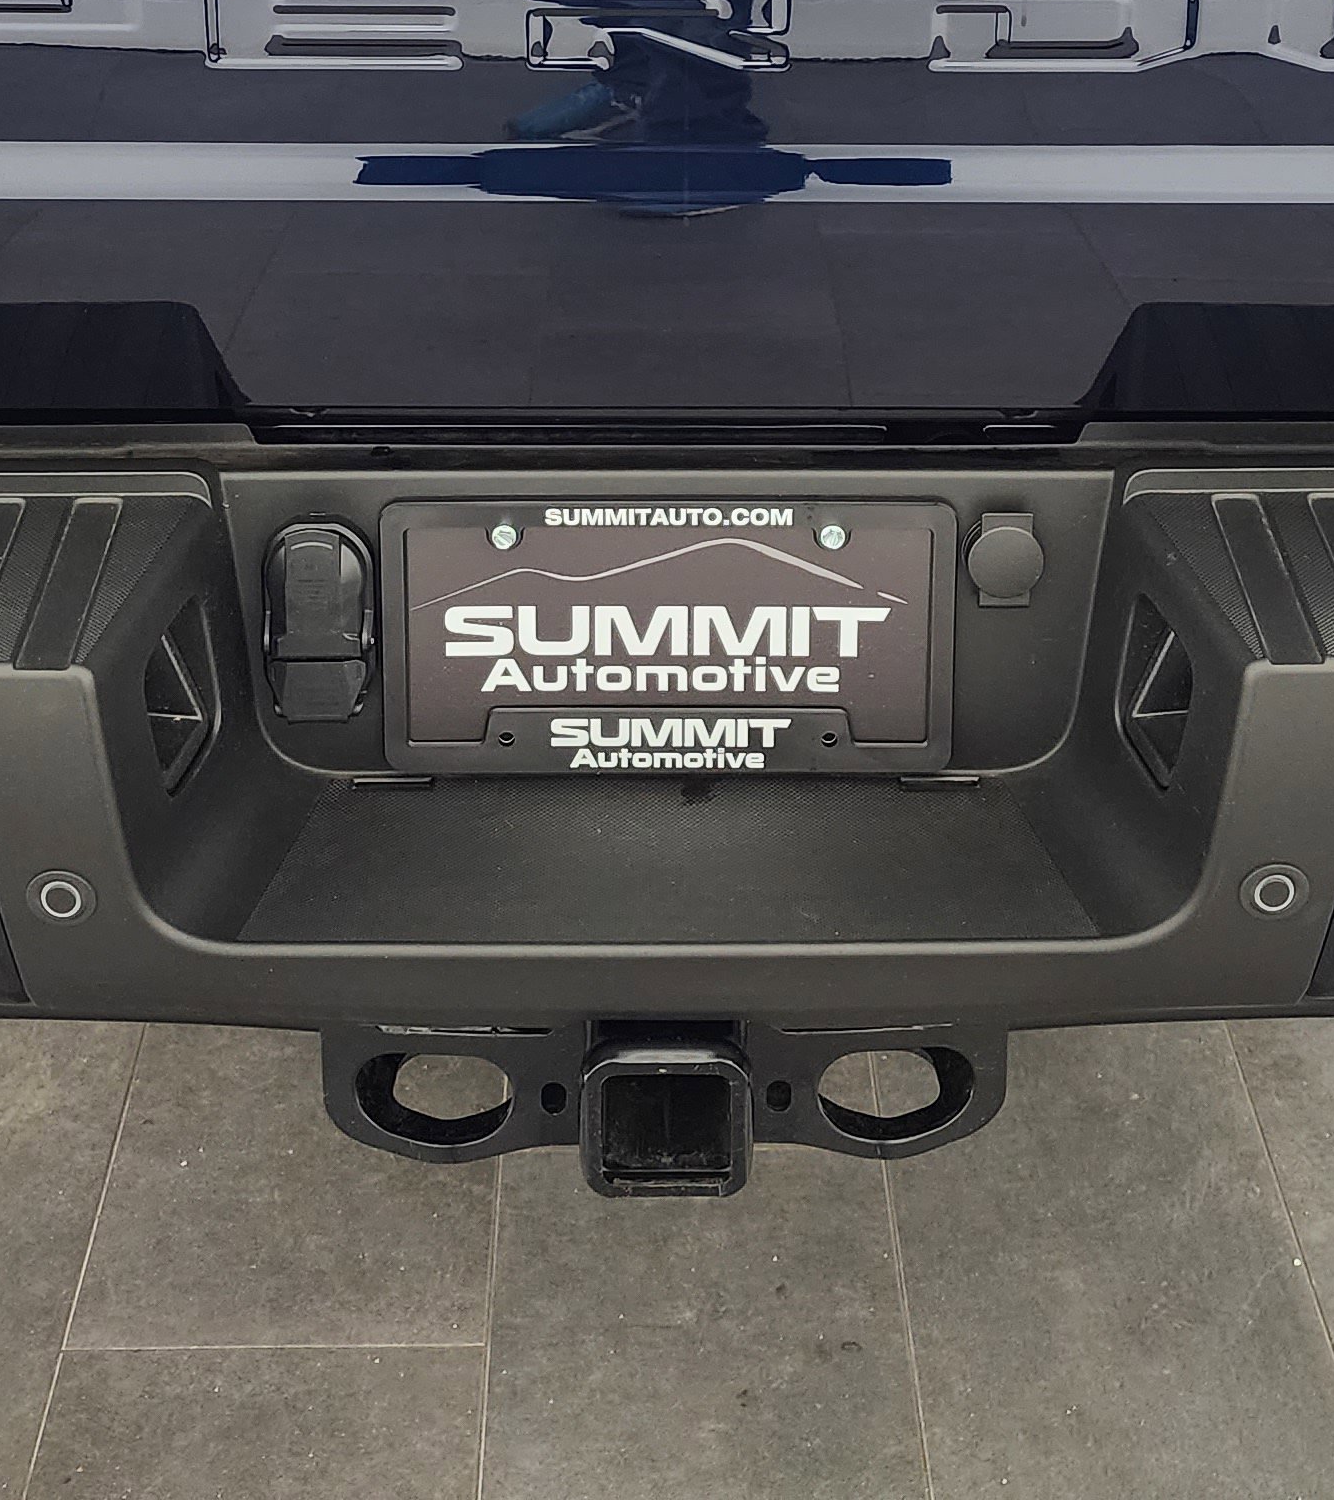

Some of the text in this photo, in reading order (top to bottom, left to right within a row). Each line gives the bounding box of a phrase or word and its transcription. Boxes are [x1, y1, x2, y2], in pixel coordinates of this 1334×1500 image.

[544, 507, 793, 527] SUMMITAUTO.COM
[444, 605, 891, 657] SUMMIT
[481, 658, 840, 692] Automotive
[550, 718, 791, 748] SUMMIT
[569, 748, 765, 769] Automotive
